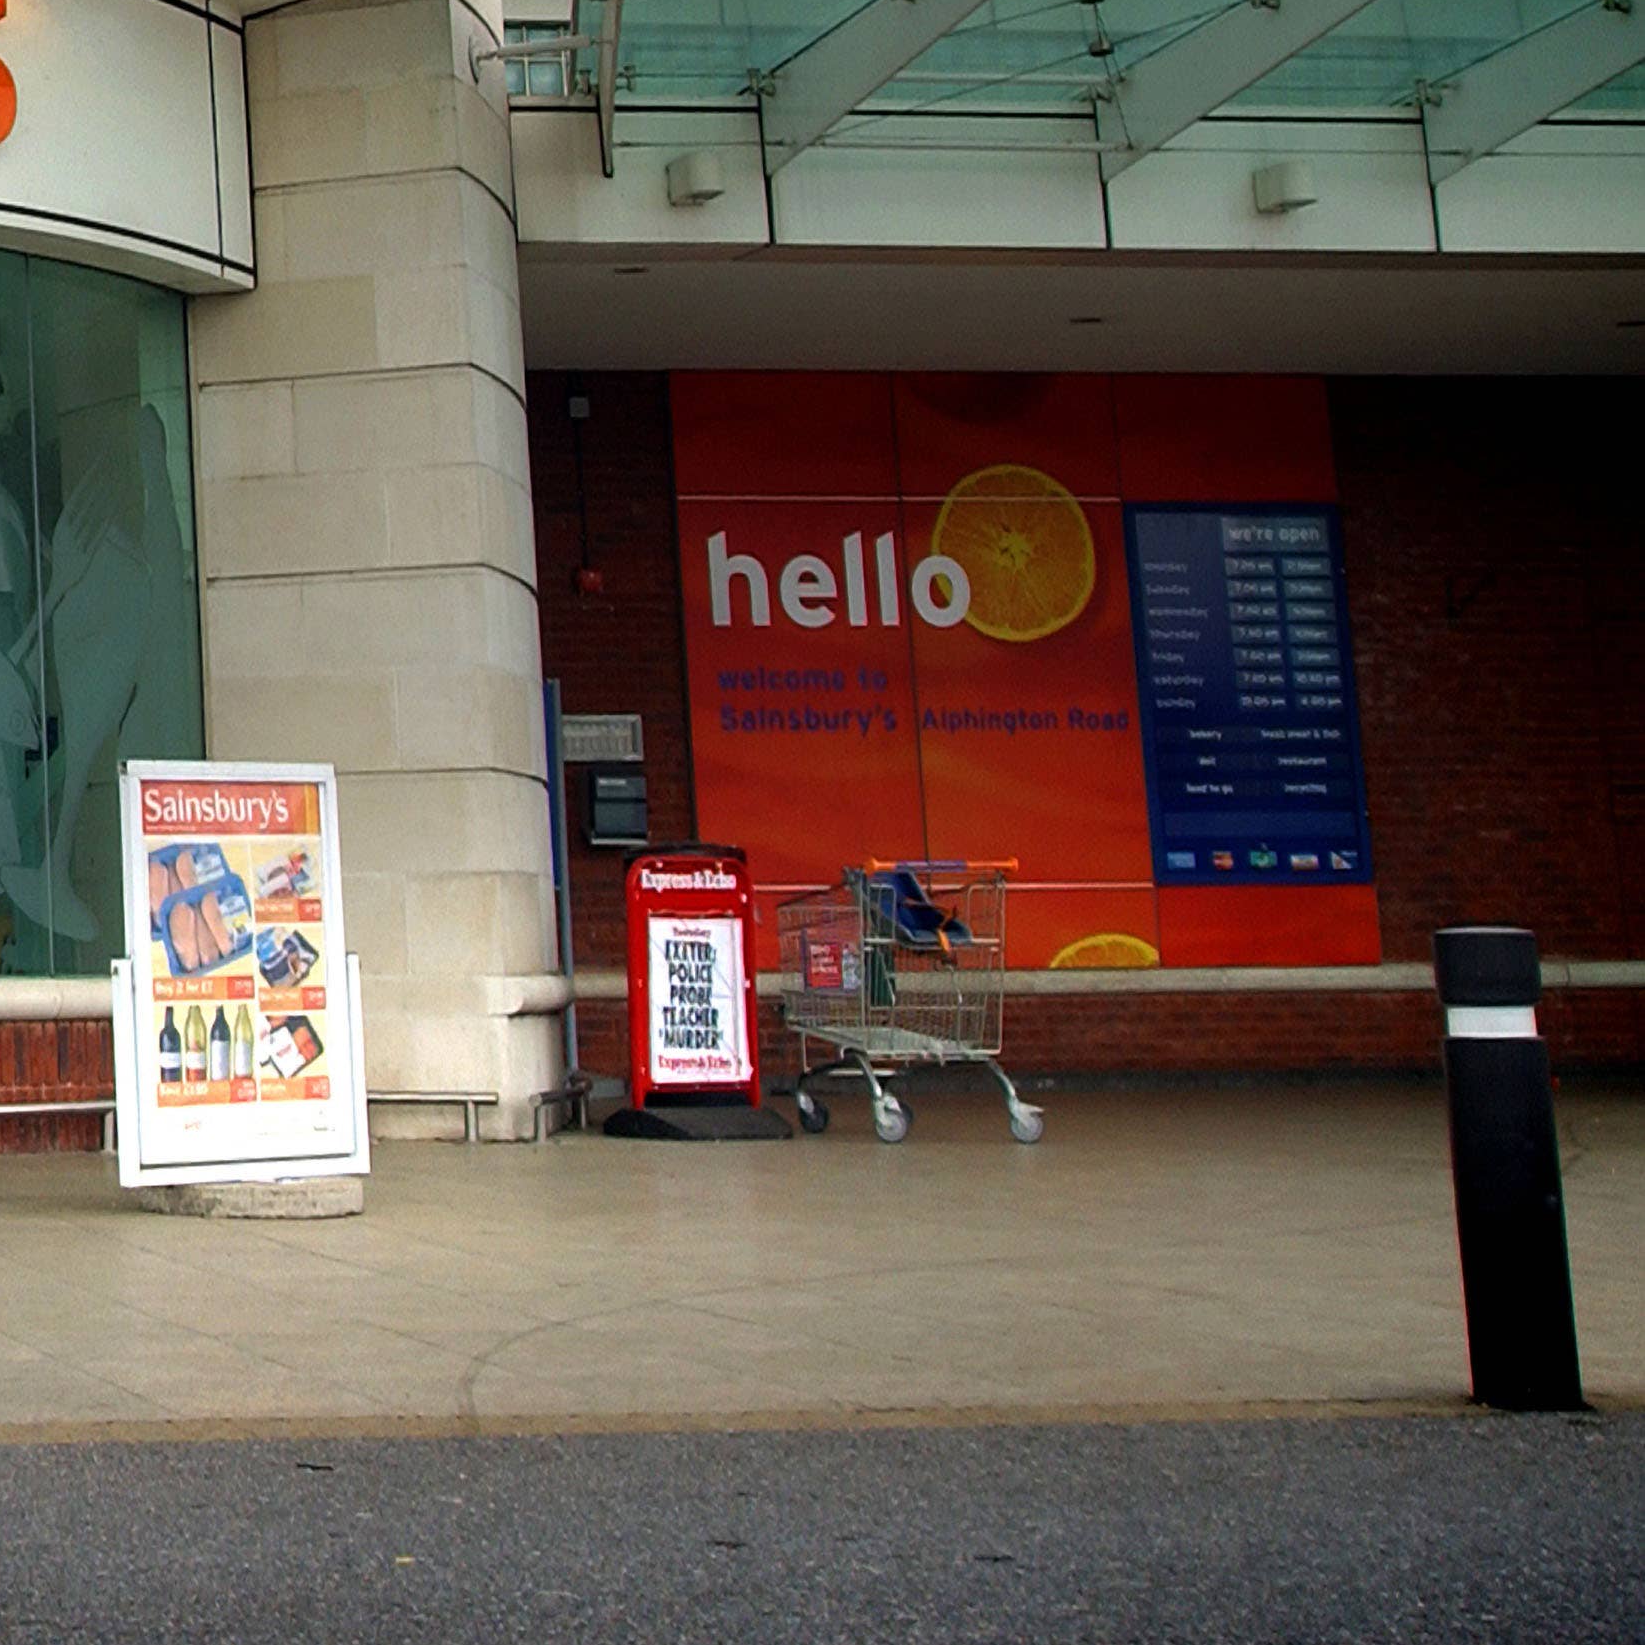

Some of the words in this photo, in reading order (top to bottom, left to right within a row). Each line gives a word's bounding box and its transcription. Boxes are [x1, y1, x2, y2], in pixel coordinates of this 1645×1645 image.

[1279, 527, 1320, 544] open
[707, 530, 971, 628] hello
[717, 666, 846, 692] welcome
[858, 667, 888, 692] to
[720, 704, 898, 736] Sainsbury's
[922, 706, 1058, 735] Alphington
[1067, 707, 1130, 731] Road
[144, 788, 289, 829] Sainsbury's
[668, 962, 713, 983] POLICE
[669, 984, 712, 1006] PROBE
[662, 1006, 720, 1028] TEACHER
